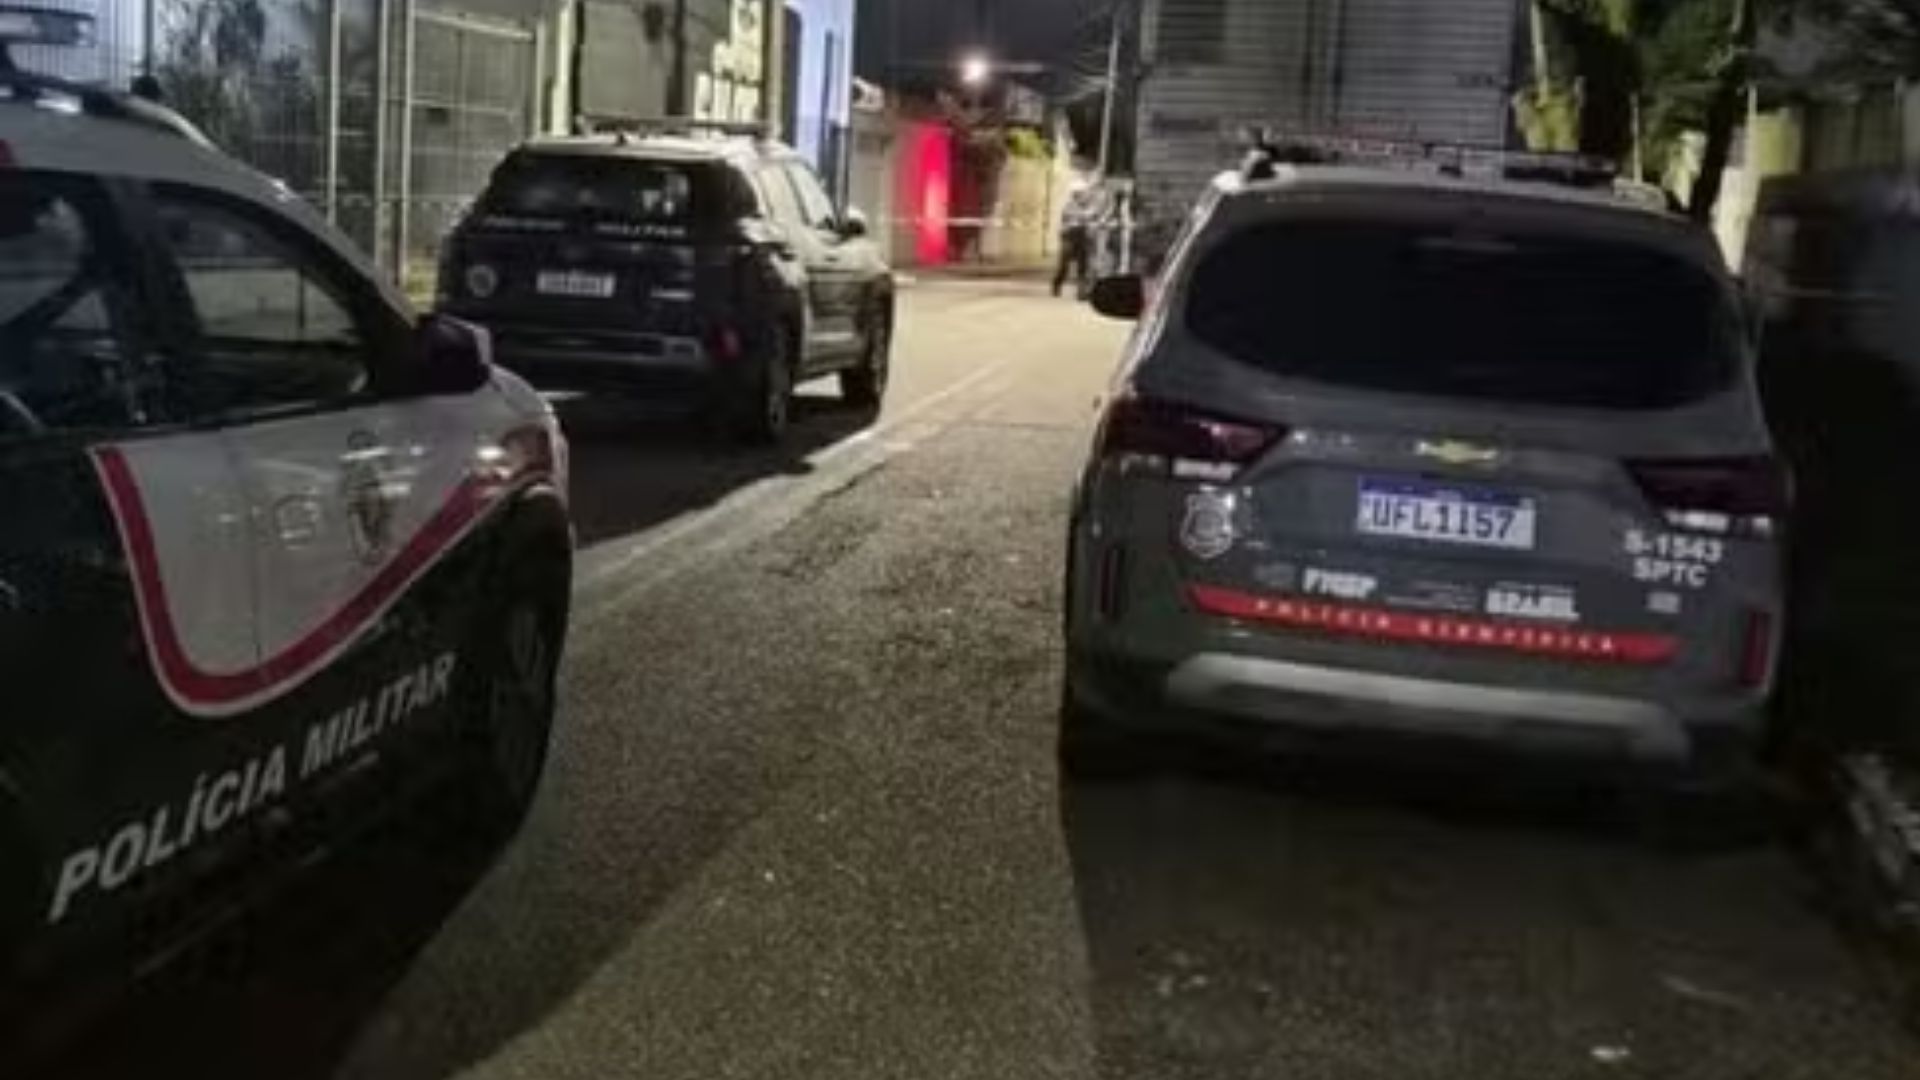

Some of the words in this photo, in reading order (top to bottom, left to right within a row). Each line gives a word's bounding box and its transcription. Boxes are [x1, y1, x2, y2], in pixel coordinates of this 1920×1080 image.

[1633, 556, 1707, 588] SPTC
[48, 743, 287, 924] POLÍCIA
[299, 651, 456, 781] MILITAR
